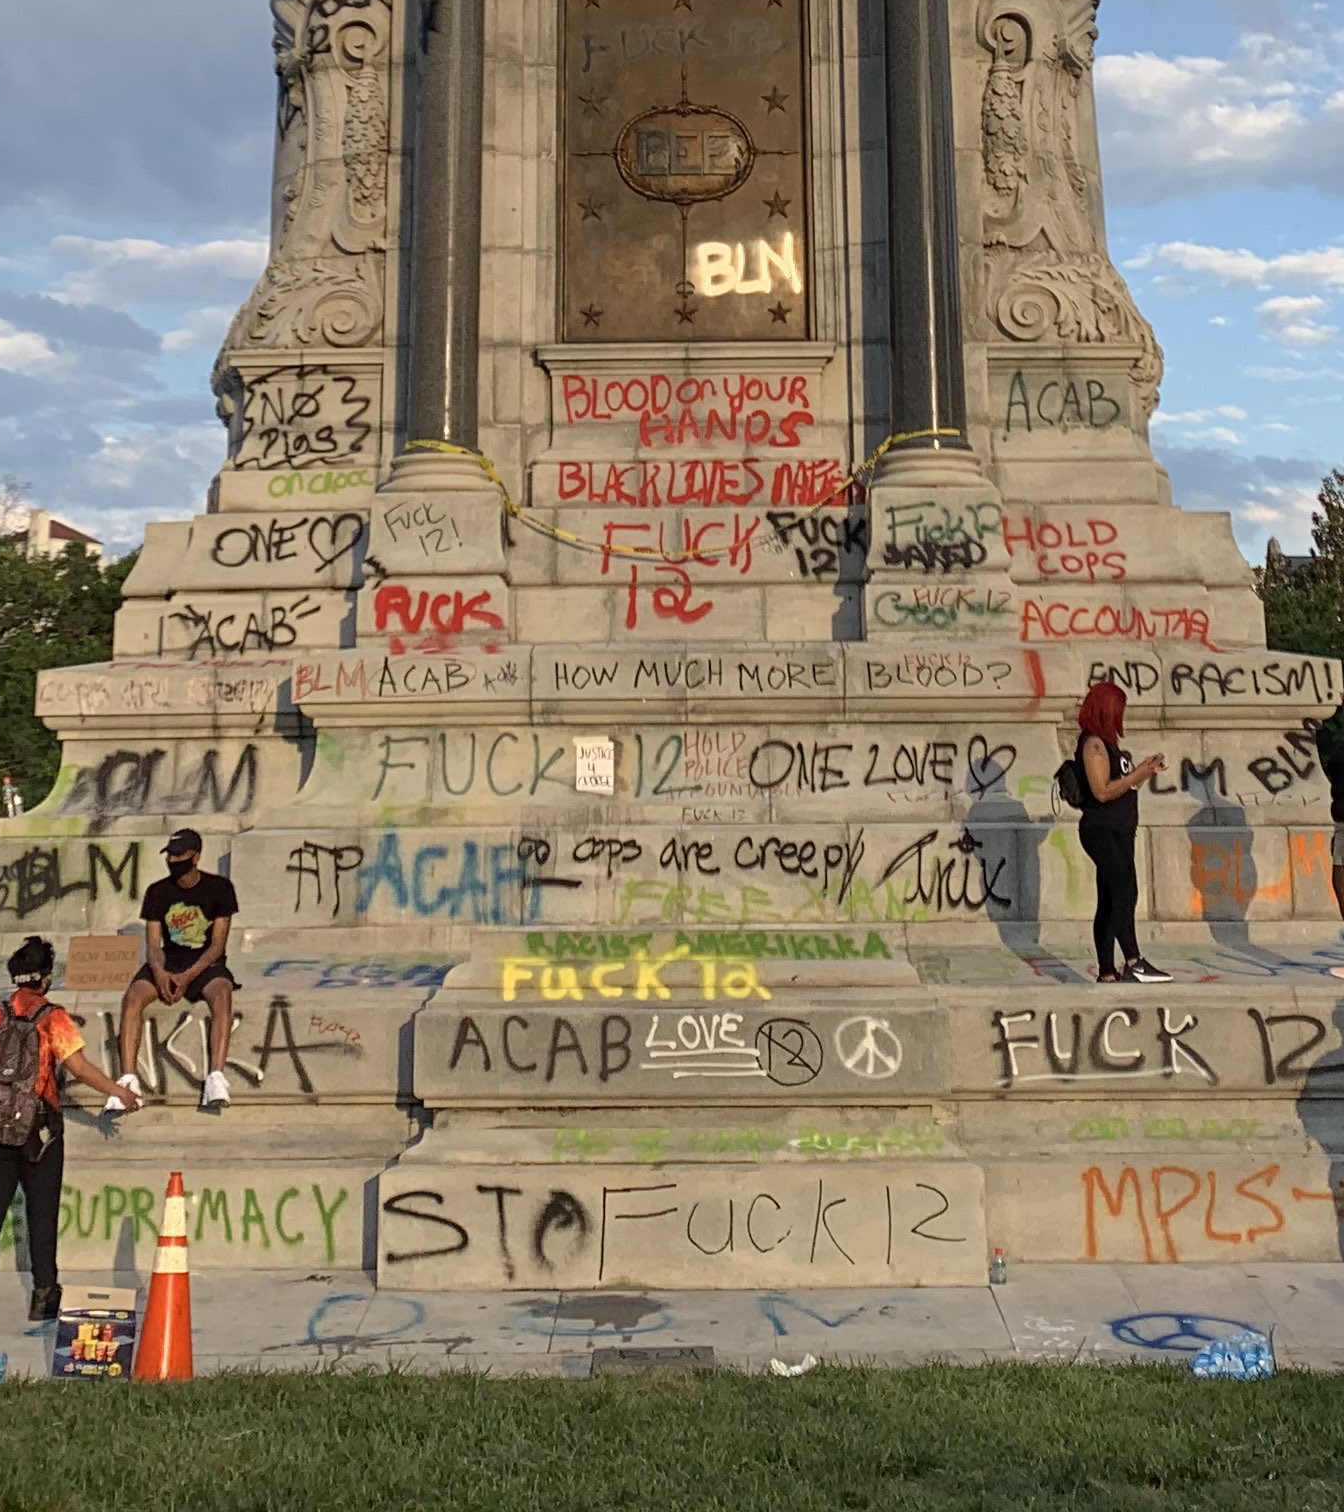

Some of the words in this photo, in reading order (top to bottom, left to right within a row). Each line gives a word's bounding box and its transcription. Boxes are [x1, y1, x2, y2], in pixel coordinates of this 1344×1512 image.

[563, 375, 670, 423] BLOOD
[723, 375, 809, 413] YOUR
[1003, 371, 1120, 442] ACAB
[640, 408, 814, 447] HANDS
[211, 518, 309, 568] ONE
[601, 514, 760, 575] FUCK
[766, 511, 867, 556] FUCK
[1002, 516, 1117, 557] HOLD
[795, 547, 838, 582] 12
[1037, 552, 1127, 582] COPS
[375, 586, 504, 635] FUCK
[626, 564, 713, 630] 12
[913, 588, 975, 611] FUCK
[291, 661, 364, 703] BLM
[378, 657, 470, 696] ACAB
[555, 661, 619, 692] HOW
[633, 658, 723, 691] MUCH
[737, 661, 837, 693] MORE
[865, 661, 1013, 691] BLOOD?
[1087, 661, 1159, 697] END
[1170, 659, 1335, 704] RACISM!
[370, 731, 565, 801] FUCK
[634, 733, 703, 798] 12
[683, 730, 747, 762] HOLD
[683, 757, 747, 781] POLICE
[749, 741, 853, 793] ONE
[864, 741, 957, 786] LOVE
[587, 763, 596, 776] 4
[681, 807, 723, 822] FUCK
[660, 838, 720, 874] are
[734, 837, 865, 905] creepy
[525, 931, 654, 959] RACIST
[675, 930, 893, 959] AMERIKKKA
[702, 957, 773, 1000] 12
[448, 1015, 633, 1082] ACAB
[644, 1014, 745, 1050] LOVE
[991, 1006, 1219, 1088] FUCK
[57, 1184, 348, 1264] SUPRMACY
[886, 1183, 967, 1265] 12
[1083, 1164, 1286, 1265] MPLS
